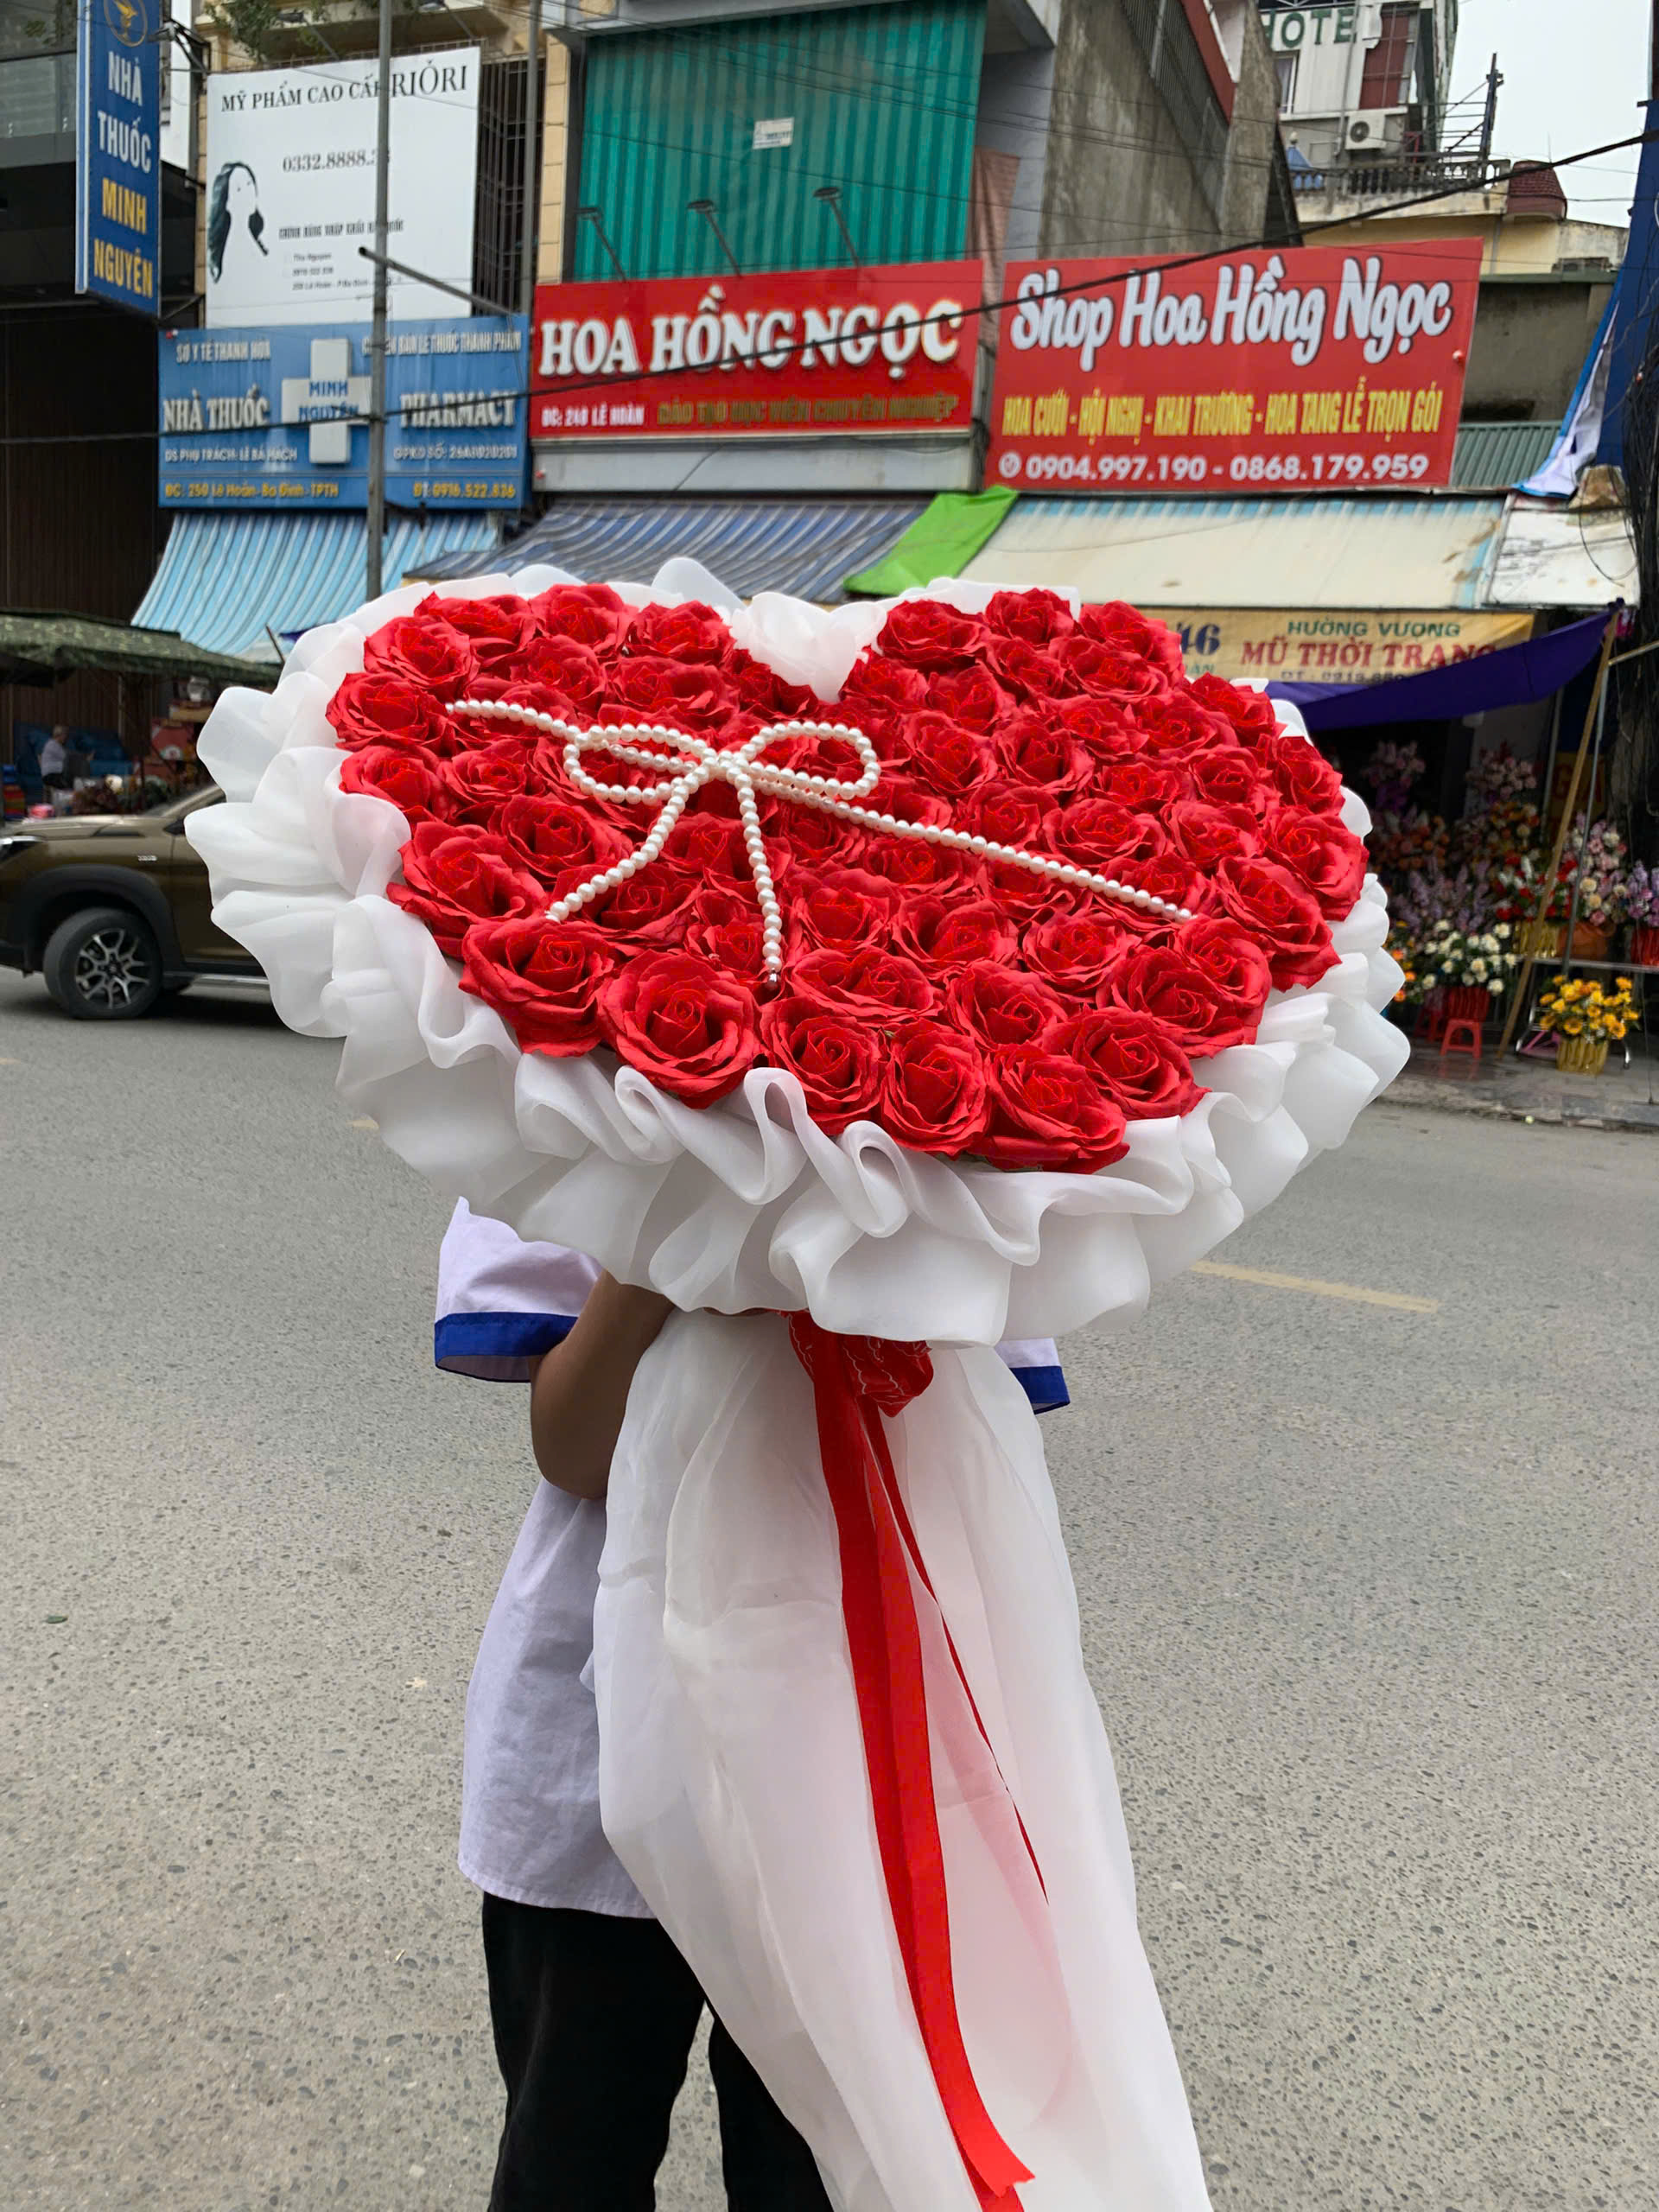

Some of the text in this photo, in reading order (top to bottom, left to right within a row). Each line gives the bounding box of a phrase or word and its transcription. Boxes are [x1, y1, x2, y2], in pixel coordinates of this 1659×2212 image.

[108, 51, 143, 106] NHÀ
[221, 90, 245, 111] MỸ
[252, 80, 302, 109] PHẨM
[308, 85, 343, 104] CAO
[98, 110, 152, 174] THUỐC
[282, 148, 391, 173] 0332.8888.
[102, 176, 147, 234] MINH
[93, 238, 154, 299] NGUYÊN
[537, 283, 964, 380] HOA HỒNG NGỌC
[1010, 254, 1452, 372] Shop Hoa Hồng Ngọc
[162, 382, 270, 431] NHÀ THUỐC
[308, 379, 348, 397] MINH
[399, 390, 516, 427] PHARMACY
[1264, 393, 1298, 435] HOA
[1300, 391, 1341, 434] TANG
[1366, 391, 1411, 442] TRỌN
[1411, 380, 1443, 432] GÓI
[1026, 454, 1207, 480] 0904.997.190
[1230, 454, 1429, 481] 0868.179.959
[1176, 622, 1221, 656] 46
[1240, 635, 1289, 666] MŨ
[1382, 644, 1497, 670] TRAN
